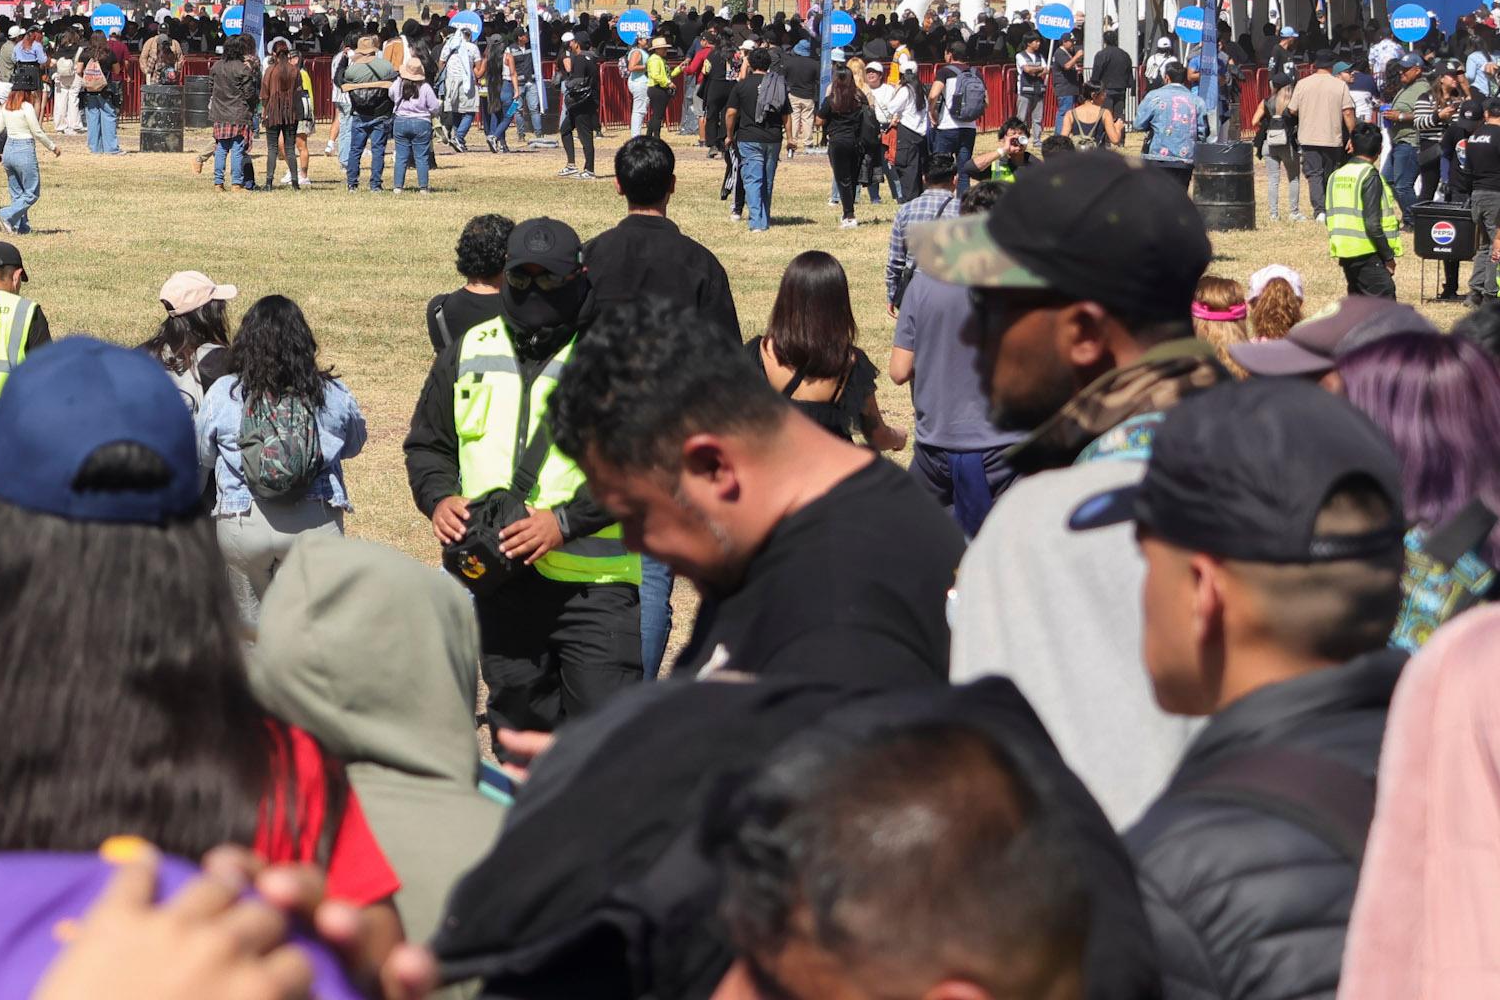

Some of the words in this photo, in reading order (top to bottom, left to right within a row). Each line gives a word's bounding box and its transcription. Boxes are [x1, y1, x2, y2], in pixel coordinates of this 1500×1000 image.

[93, 16, 122, 26] GENERAL
[1038, 15, 1071, 29] GENERAL
[1394, 17, 1427, 29] GENERAL
[619, 22, 650, 33] GENERAL
